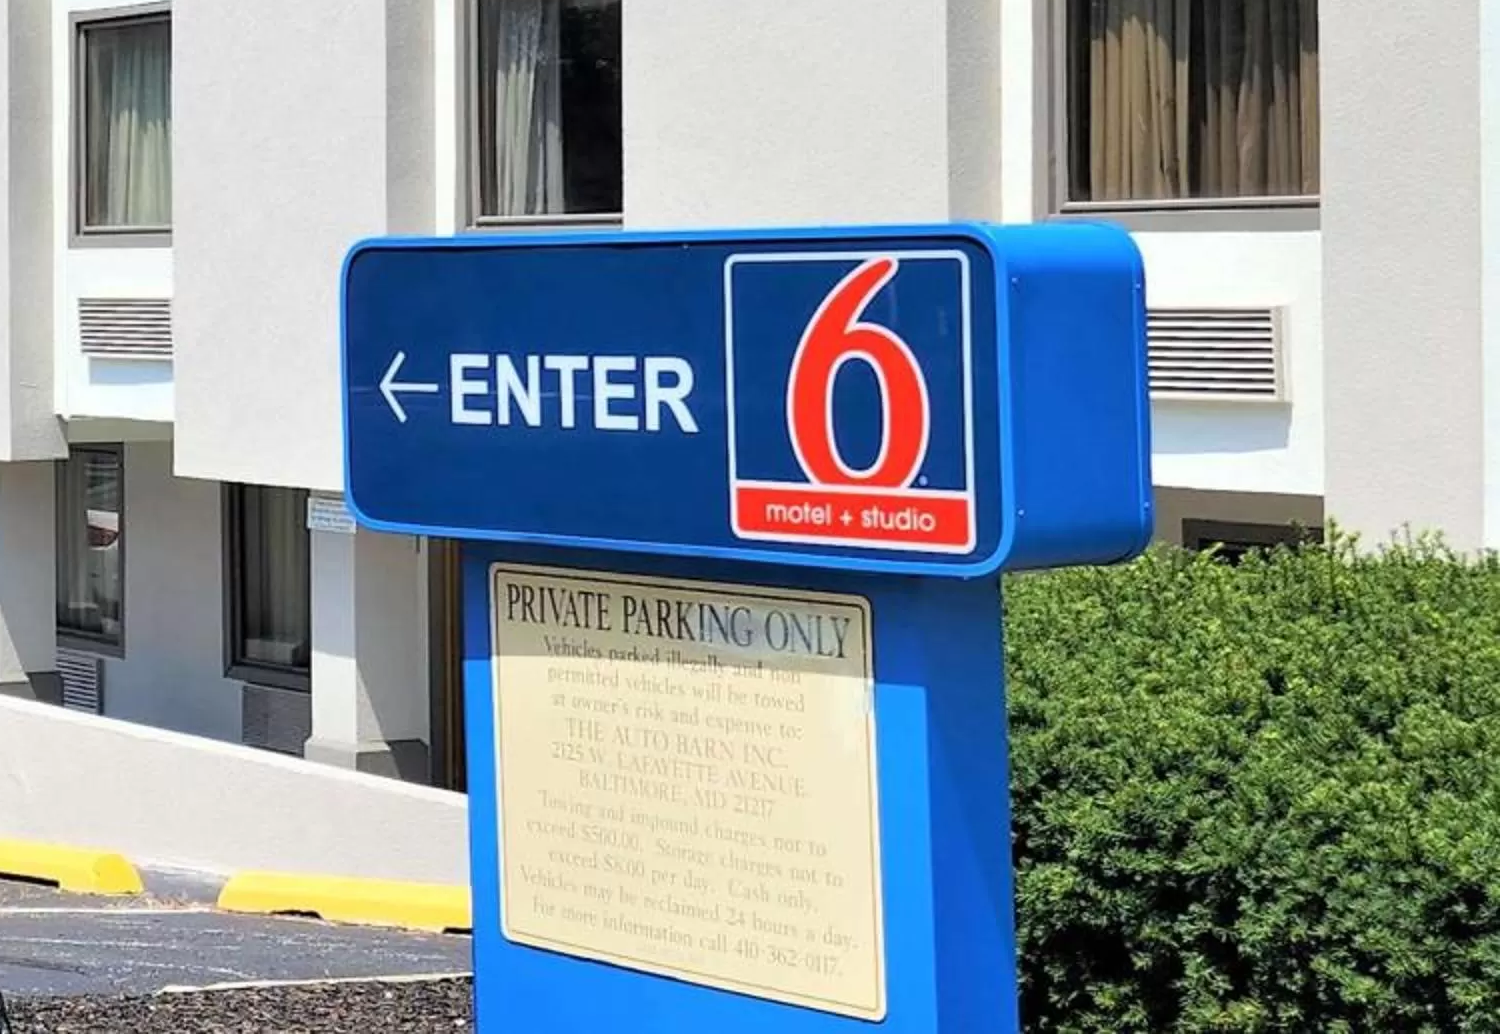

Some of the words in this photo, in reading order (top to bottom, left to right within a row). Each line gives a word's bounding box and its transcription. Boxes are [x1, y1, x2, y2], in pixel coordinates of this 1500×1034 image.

[450, 353, 700, 434] ENTER
[786, 255, 931, 488] 6
[765, 502, 832, 526] motel
[861, 508, 937, 533] studio
[506, 583, 612, 631] PRIVATE
[620, 595, 753, 647] PARKING
[764, 610, 851, 659] ONLY
[542, 635, 602, 659] Vehicles
[609, 645, 660, 669] parked
[666, 648, 726, 679] illegally
[732, 659, 763, 679] and
[547, 665, 619, 687] permitted
[624, 673, 686, 696] vehicles
[691, 682, 721, 704] will
[727, 684, 747, 704] be
[753, 692, 805, 713] towed
[565, 717, 604, 744] THE
[612, 725, 670, 753] AUTO
[675, 733, 734, 760] BARN
[571, 696, 629, 716] owner's
[635, 701, 664, 722] risk
[670, 706, 701, 727] and
[705, 716, 772, 740] expense
[779, 723, 805, 742] to:
[616, 751, 719, 784] LAFAYETTE
[537, 788, 592, 819] Towing
[598, 805, 626, 823] and
[629, 811, 699, 838] impound
[704, 819, 768, 849] charges
[772, 836, 805, 854] not
[808, 839, 829, 858] to
[694, 786, 727, 810] MD
[525, 819, 576, 840] exceed
[655, 837, 711, 868] Storage
[719, 847, 783, 878] charges
[789, 868, 818, 887] not
[824, 869, 845, 888] to
[548, 850, 598, 870] exceed
[650, 869, 677, 889] per
[728, 877, 770, 904] Cash
[519, 863, 578, 893] Vehicles
[582, 884, 614, 905] may
[619, 884, 638, 905] be
[643, 894, 720, 921] reclaimed
[724, 906, 746, 928] 24
[751, 909, 798, 938] hours
[804, 929, 817, 943] a
[822, 922, 861, 954] day.
[532, 894, 556, 918] For
[560, 906, 598, 928] more
[602, 909, 693, 949] information
[699, 932, 729, 956] call
